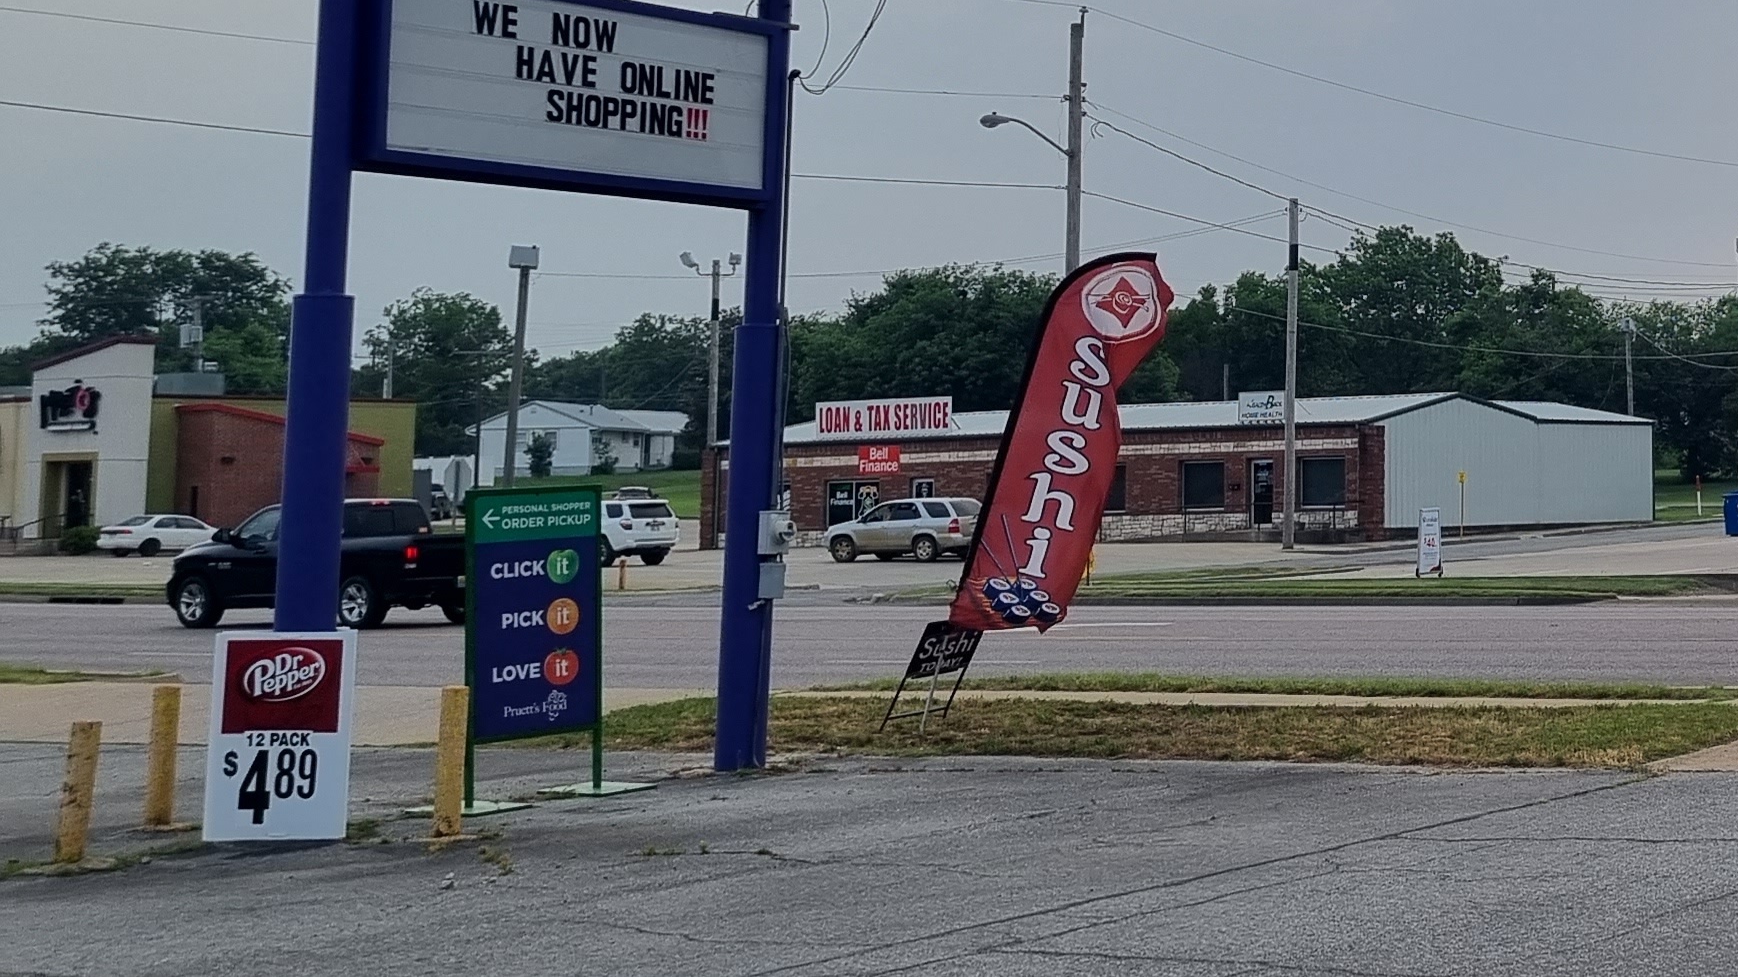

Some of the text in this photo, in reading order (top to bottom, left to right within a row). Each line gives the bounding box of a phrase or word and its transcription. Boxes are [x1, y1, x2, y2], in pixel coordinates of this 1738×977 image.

[473, 0, 617, 52] WE NOW
[515, 46, 715, 104] HAVE ONLINE
[545, 89, 709, 139] SHOPPING!!!
[819, 401, 949, 433] LOAN & TAX SERVICE
[859, 447, 899, 472] Bell Finance
[836, 491, 848, 499] Bell
[501, 502, 591, 514] PERSONAL SHOPPER
[501, 514, 591, 529] ORDER PICKUP
[490, 557, 569, 579] CLICK it
[501, 607, 569, 629] PICK it
[919, 631, 978, 659] Sushi
[275, 654, 304, 677] Dr
[492, 659, 568, 683] LOVE it
[253, 659, 320, 697] Pepper
[503, 699, 567, 717] Pruett's Food
[246, 733, 310, 747] 12 PACK
